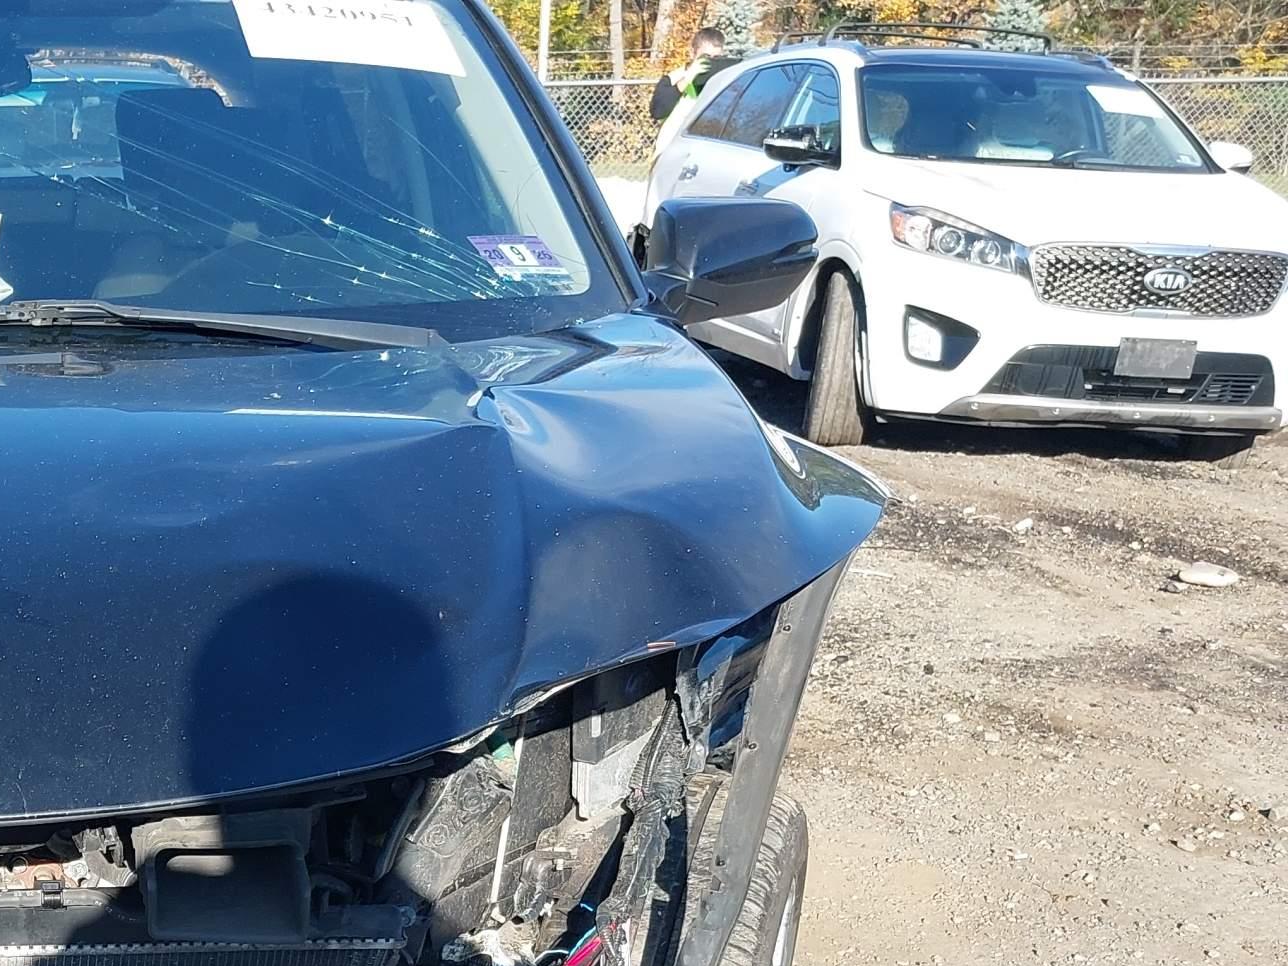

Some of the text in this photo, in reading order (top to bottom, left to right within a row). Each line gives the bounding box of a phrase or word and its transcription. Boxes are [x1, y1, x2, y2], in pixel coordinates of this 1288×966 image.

[483, 248, 504, 261] 20
[509, 245, 527, 263] 9
[1153, 273, 1186, 290] KIA
